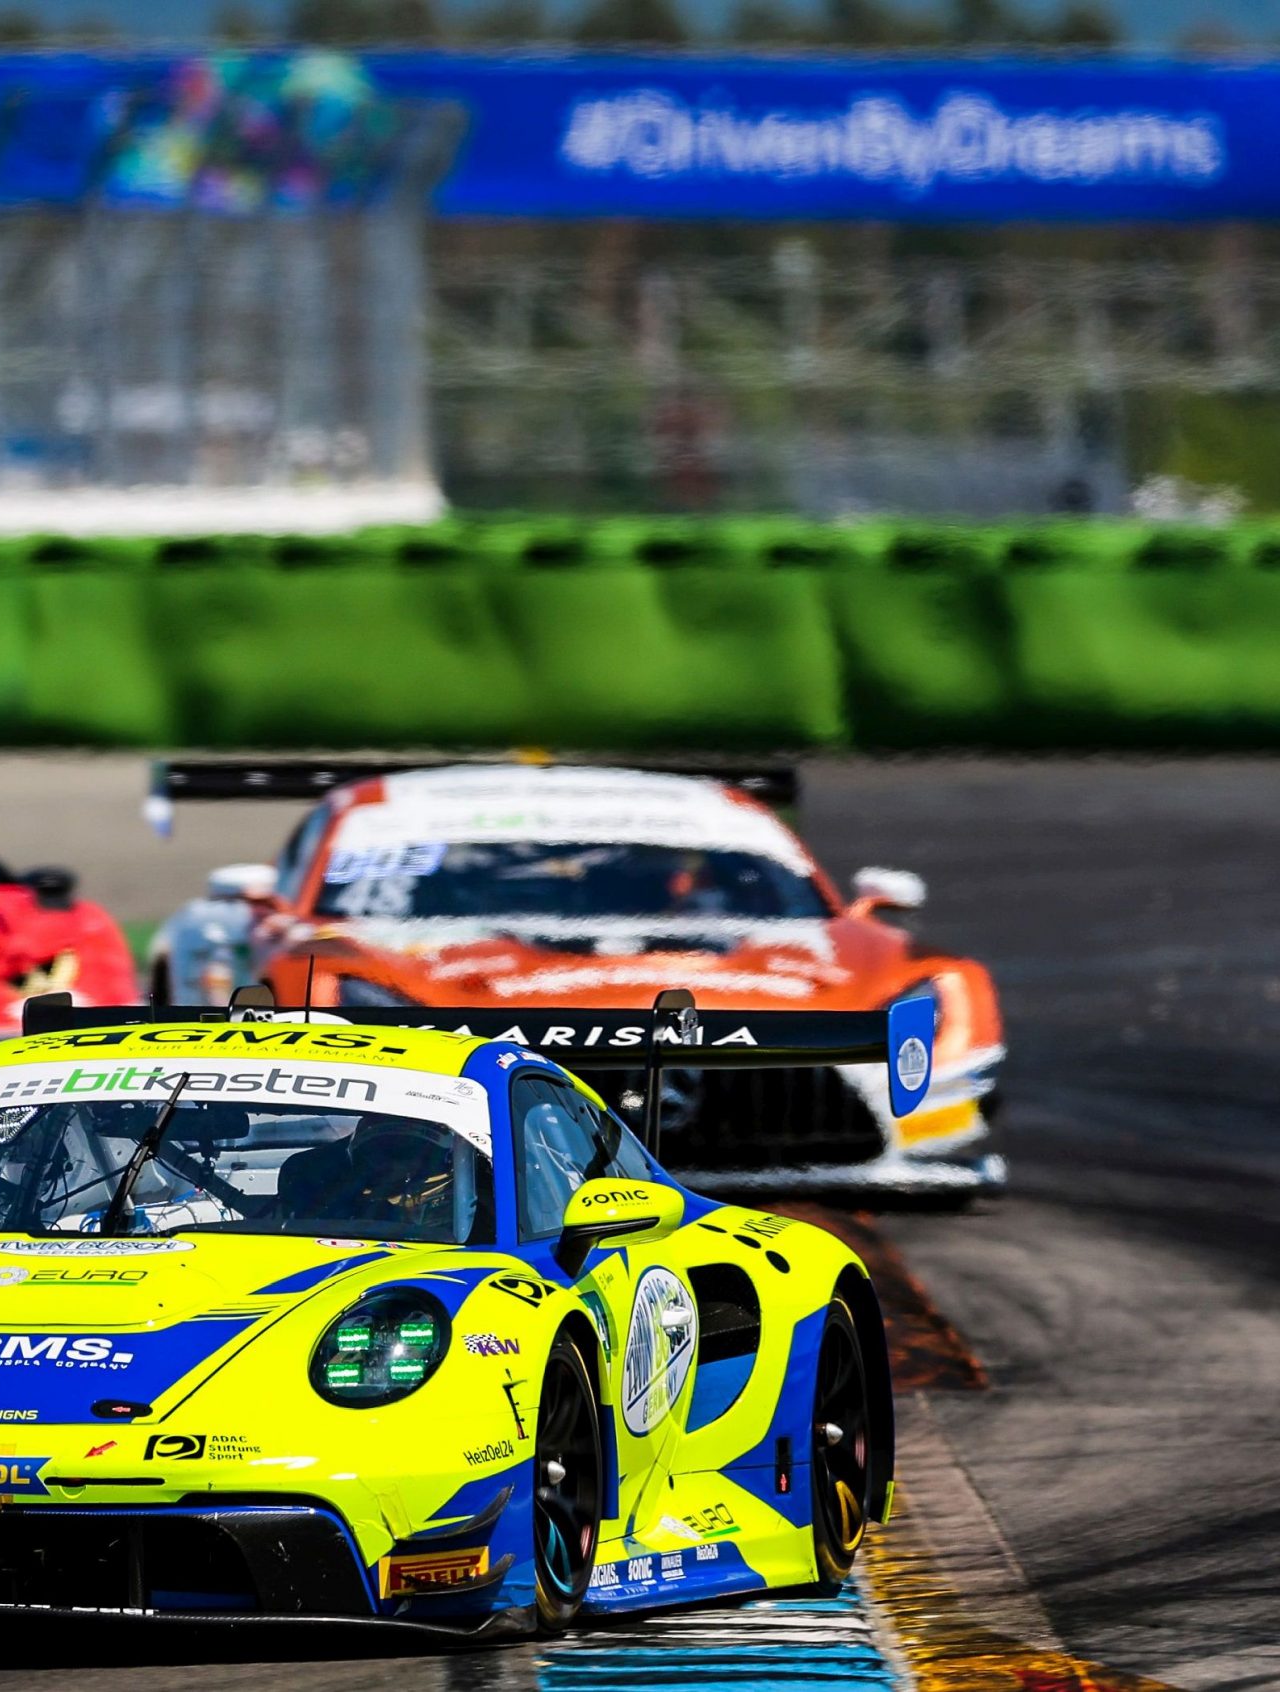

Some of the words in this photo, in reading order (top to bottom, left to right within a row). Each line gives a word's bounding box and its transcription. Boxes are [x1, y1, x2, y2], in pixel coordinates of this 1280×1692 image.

[563, 93, 1222, 188] #DrivenByDreams
[127, 1043, 183, 1052] YOUR
[194, 1044, 283, 1053] DISPLAY
[293, 1047, 399, 1063] COMPANY
[62, 1066, 378, 1101] bitkasten
[76, 1240, 177, 1251] BUSCH
[30, 1269, 149, 1281] EURO
[475, 1338, 521, 1357] KW
[209, 1444, 261, 1453] Stiftung
[211, 1435, 248, 1443] ADAC
[463, 1440, 515, 1466] HeizOel24
[682, 1503, 734, 1533] EURO
